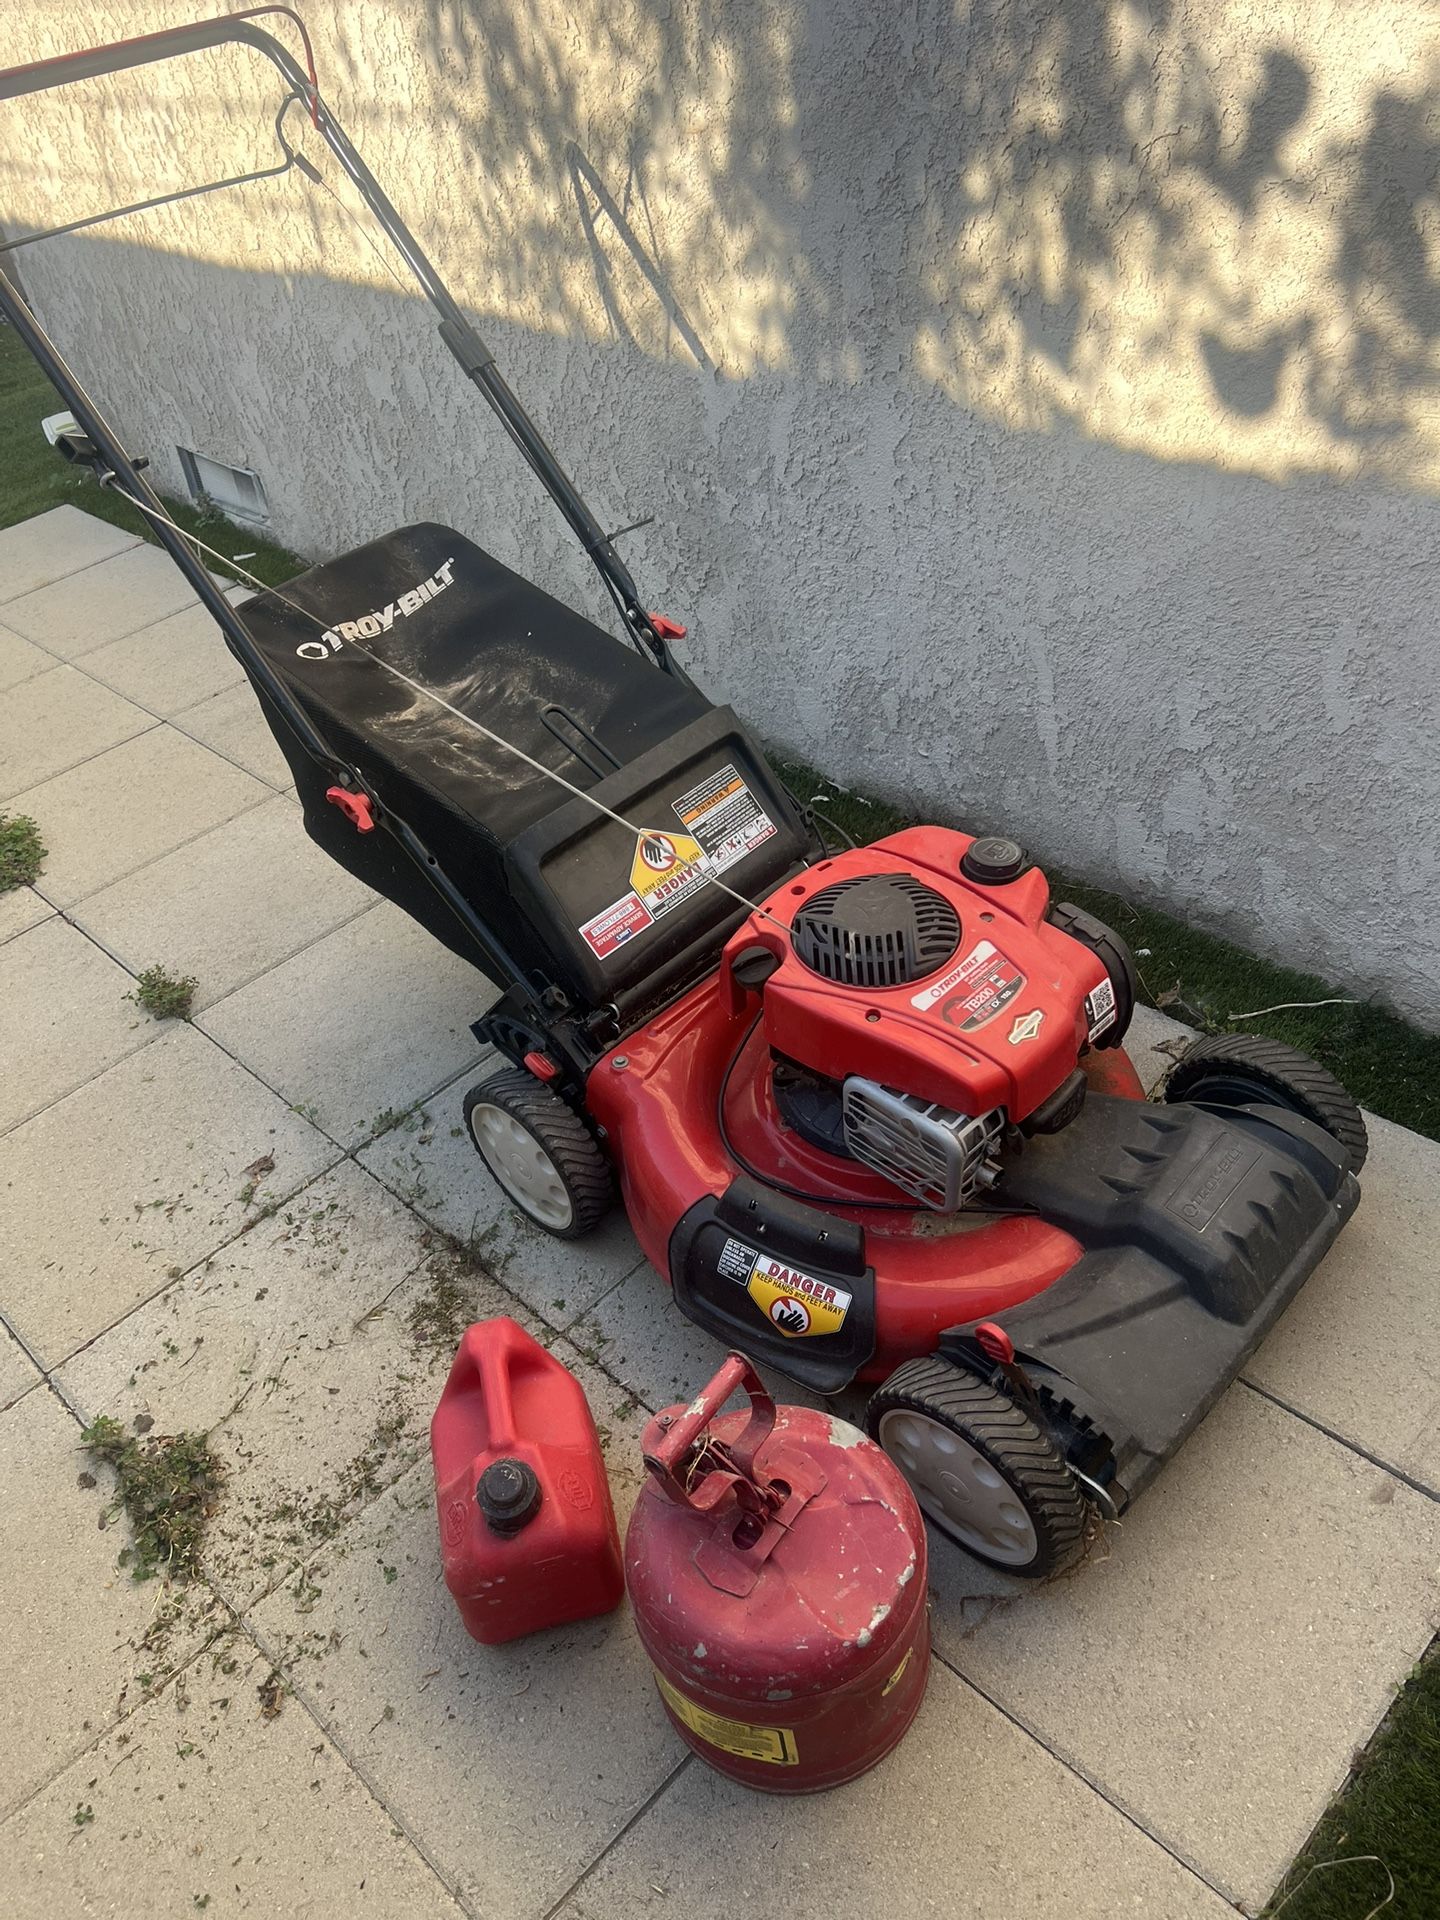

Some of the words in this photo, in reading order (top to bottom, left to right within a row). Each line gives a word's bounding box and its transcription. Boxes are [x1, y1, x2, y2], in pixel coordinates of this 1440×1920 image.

[321, 560, 454, 652] TROY-BILT
[695, 790, 726, 814] WARNING
[940, 955, 979, 992] TROY-BILT
[962, 987, 995, 1012] TB200
[756, 1273, 773, 1285] KEEP
[773, 1280, 794, 1296] HANDS
[794, 1291, 806, 1301] and
[805, 1293, 823, 1308] FEET
[822, 1303, 843, 1317] AWAY
[767, 1262, 837, 1303] DANGER
